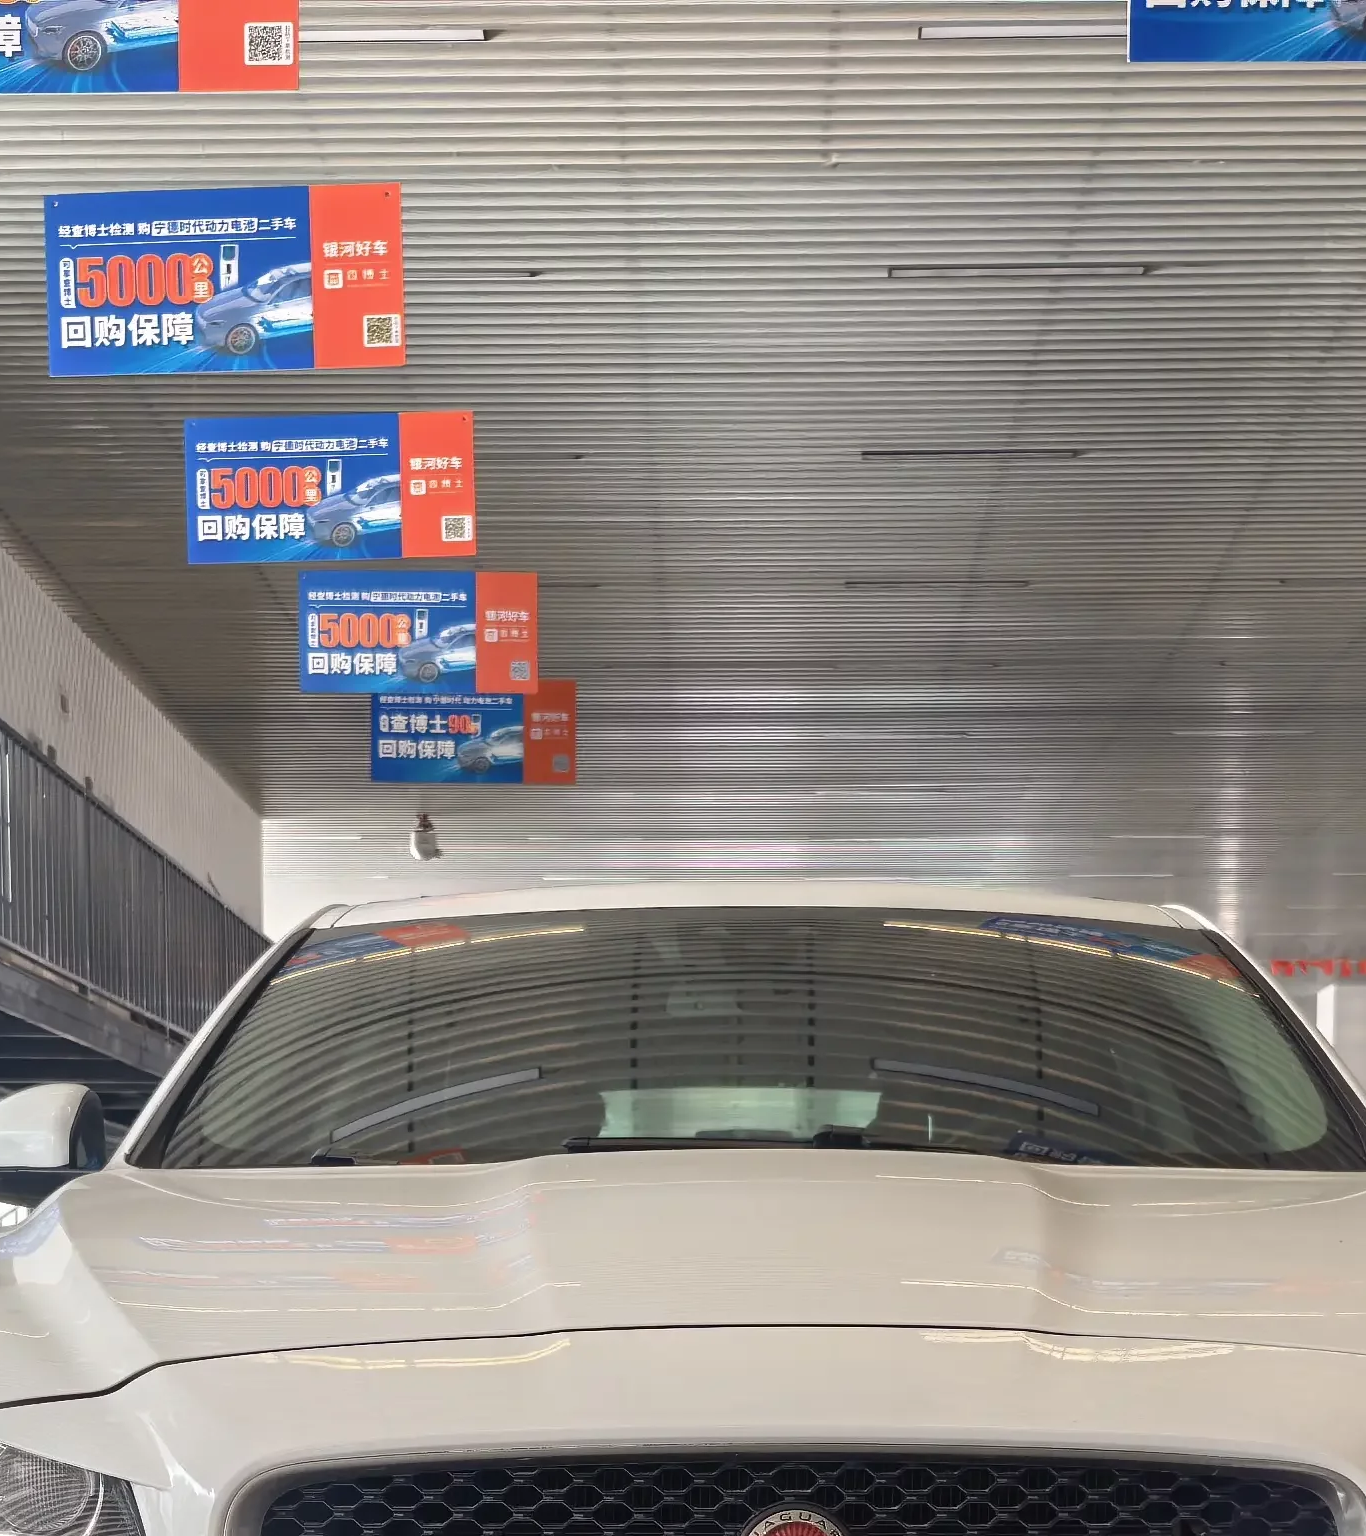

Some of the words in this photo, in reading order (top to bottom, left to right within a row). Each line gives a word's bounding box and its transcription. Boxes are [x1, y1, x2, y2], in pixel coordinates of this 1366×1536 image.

[322, 241, 388, 258] 银河好车
[59, 312, 195, 349] 回购保障
[197, 512, 306, 542] 回购保障
[307, 652, 398, 675] 回购保障
[378, 739, 456, 760] 回购保障
